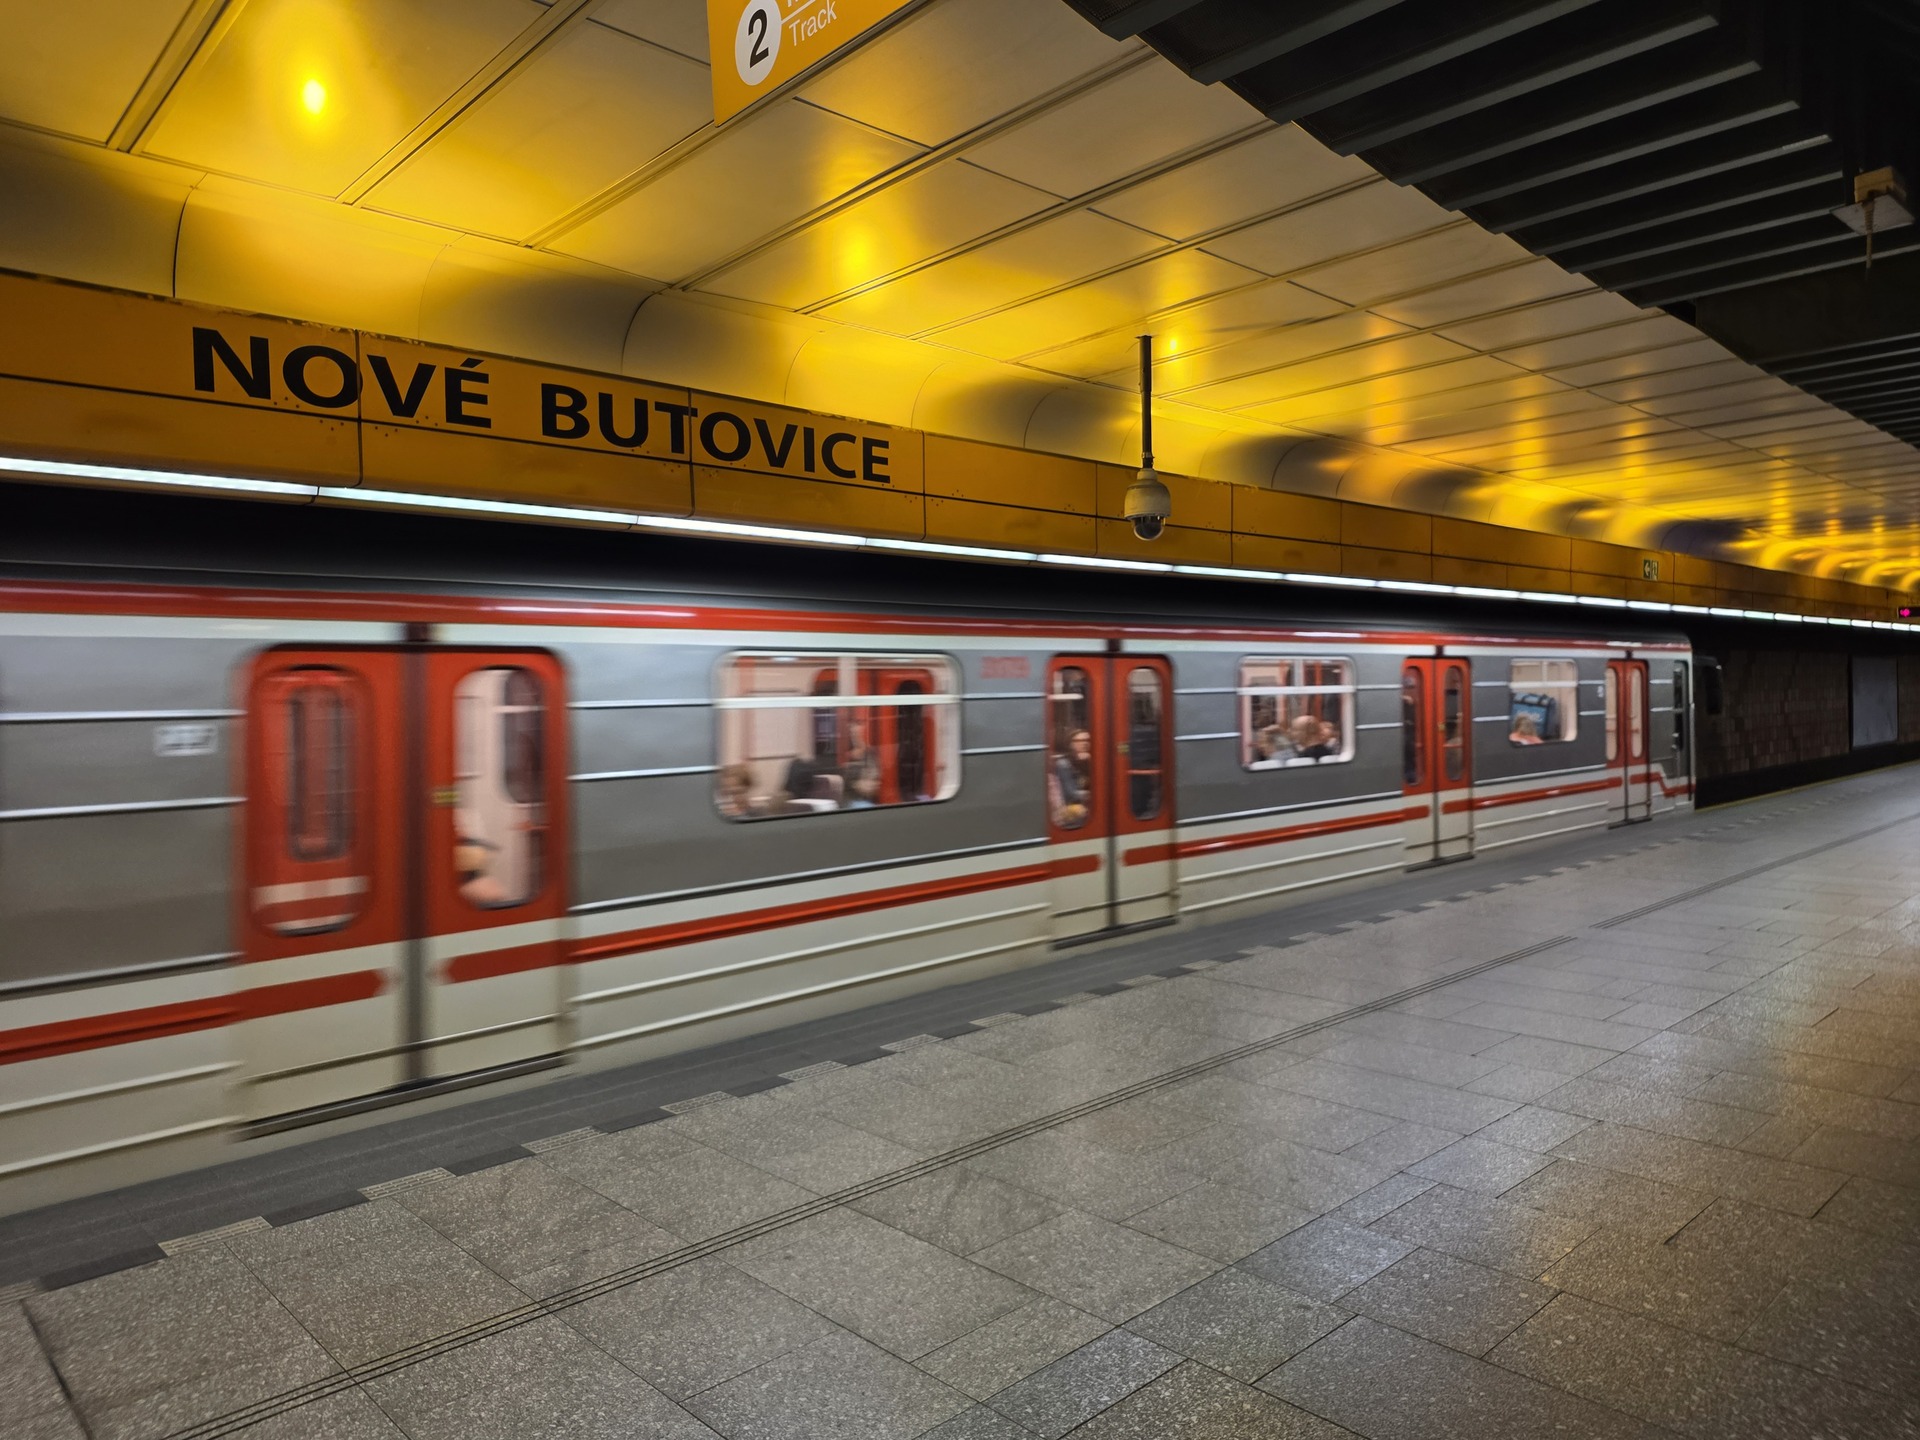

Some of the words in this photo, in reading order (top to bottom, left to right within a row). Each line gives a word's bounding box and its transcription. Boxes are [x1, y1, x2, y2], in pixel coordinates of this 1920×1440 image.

[748, 8, 769, 68] 2
[788, 0, 837, 46] Track
[192, 326, 492, 429] NOVÉ
[541, 383, 891, 484] BUTOVICE
